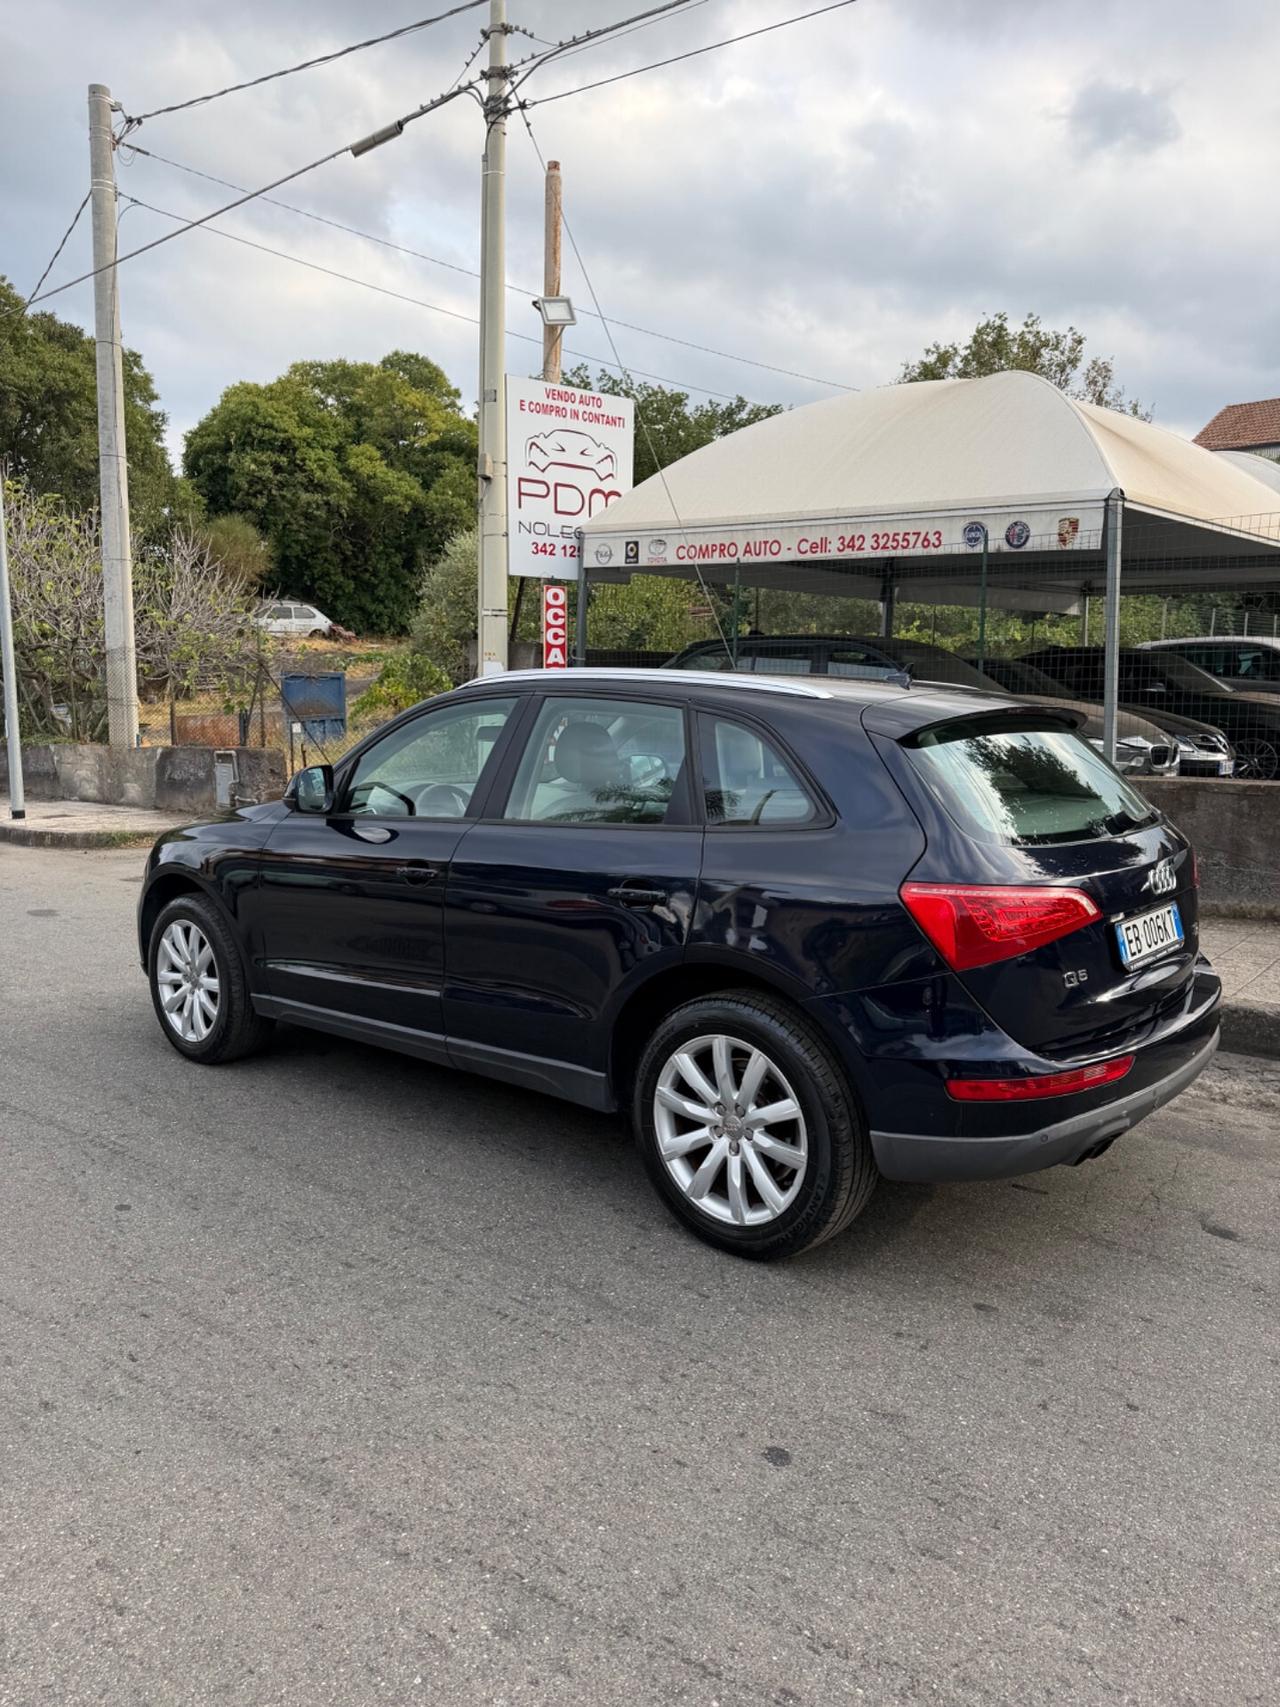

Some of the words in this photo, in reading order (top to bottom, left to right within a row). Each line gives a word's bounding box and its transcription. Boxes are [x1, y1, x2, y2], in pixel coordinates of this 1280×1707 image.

[545, 387, 576, 403] VENDO
[579, 394, 602, 408] AUTO
[519, 399, 526, 411] E
[528, 401, 567, 418] COMPRO
[570, 408, 579, 420] IN
[582, 411, 625, 428] CONTANTI
[532, 541, 556, 556] 342
[676, 542, 739, 560] COMPRO
[743, 539, 782, 557] AUTO
[797, 537, 832, 554] Cell:
[837, 535, 866, 552] 342
[870, 530, 943, 550] 3255763
[546, 588, 565, 668] OCCA
[1124, 923, 1143, 957] EB
[1143, 909, 1176, 949] 006KT
[1063, 969, 1089, 988] Q5
